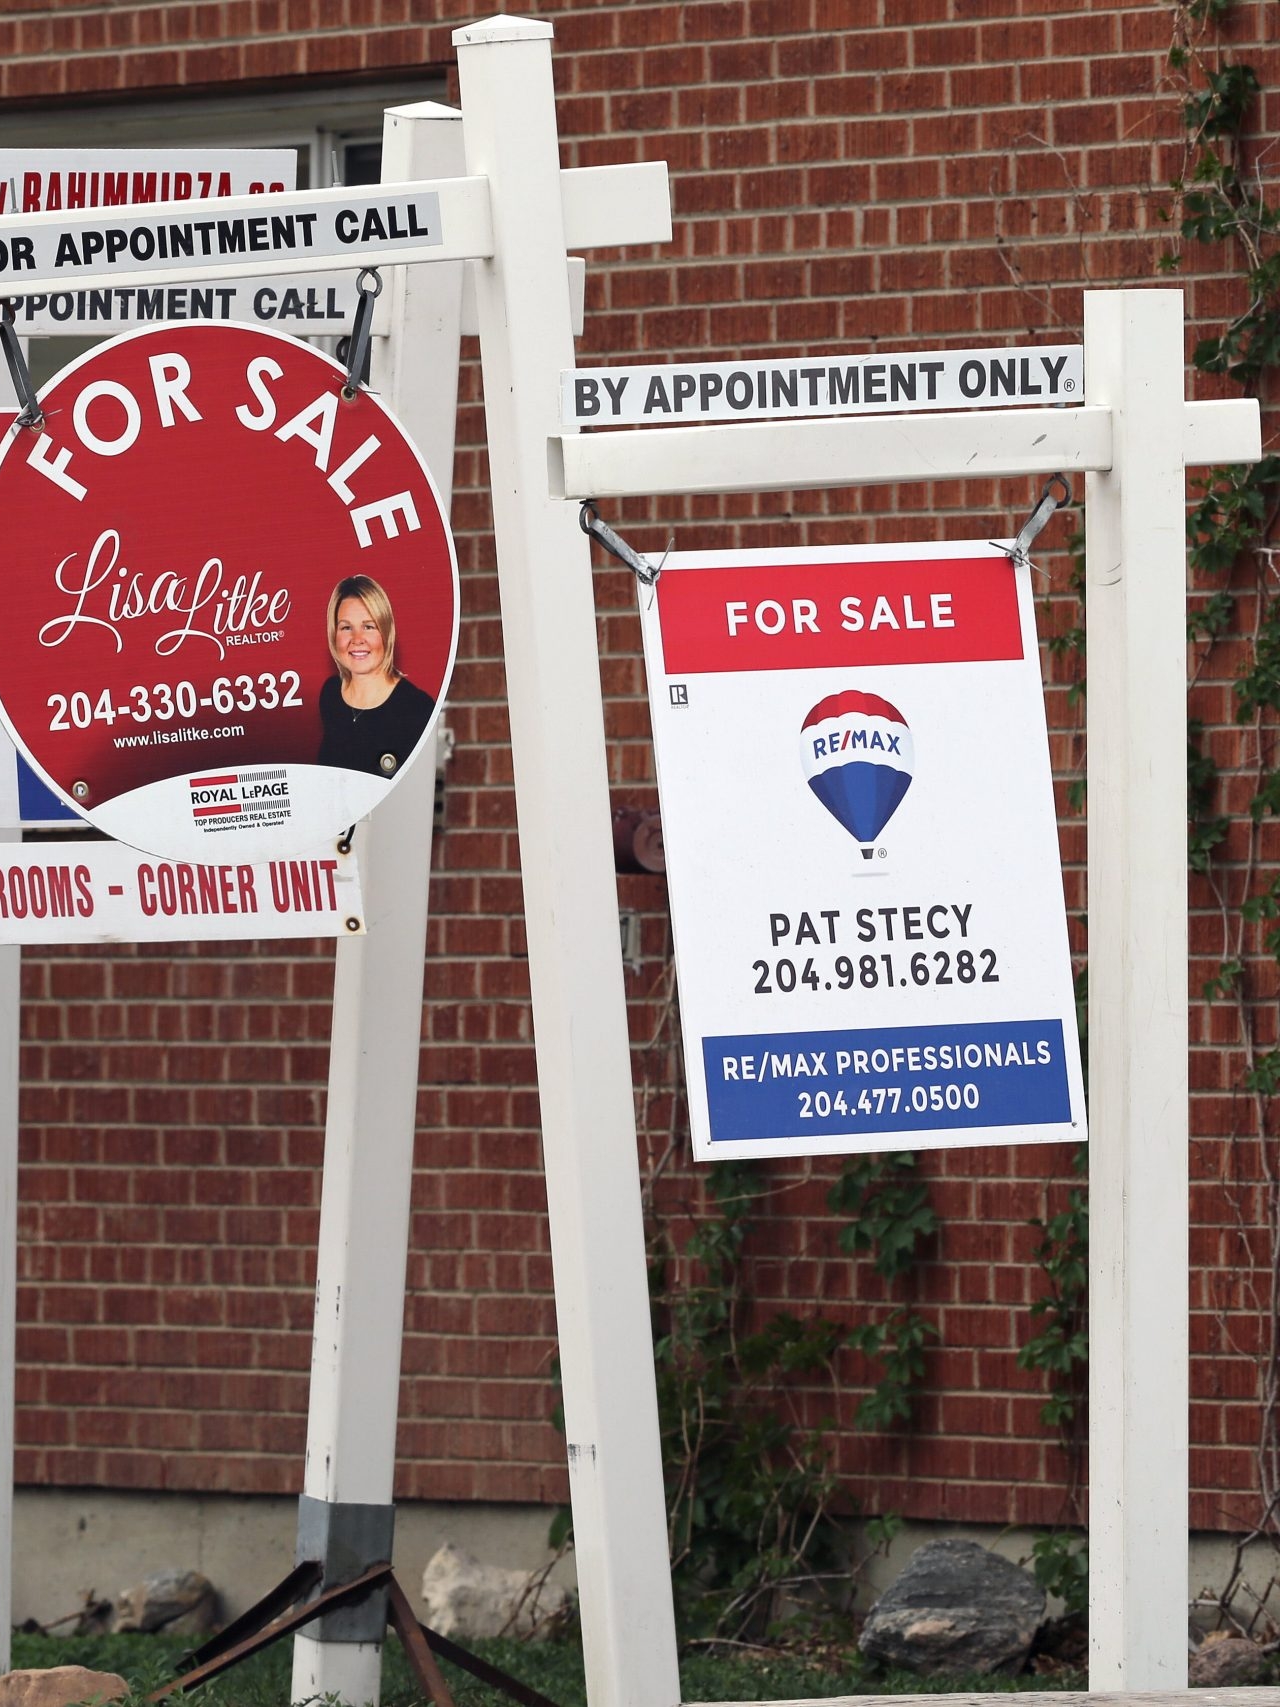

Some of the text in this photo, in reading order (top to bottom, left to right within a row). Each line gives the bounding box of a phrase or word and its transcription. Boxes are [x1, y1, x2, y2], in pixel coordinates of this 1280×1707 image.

[55, 213, 318, 268] APPOINTMENT
[334, 204, 428, 245] CALL
[253, 287, 345, 320] CALL
[575, 376, 630, 417] BY
[643, 361, 945, 414] APPOINTMENT
[26, 352, 421, 549] FOR SALE
[39, 529, 291, 661] Lisa Litke
[726, 592, 955, 637] FOR SALE
[47, 670, 303, 731] 204-330-6332
[113, 724, 245, 748] www.lisalitke.com
[813, 729, 901, 759] RE/MAX
[191, 788, 237, 804] ROYAL
[194, 809, 292, 827] TOP PRODUCERS REAL ESTATE
[204, 825, 237, 833] Independently
[262, 820, 284, 828] Operated
[137, 863, 258, 916] CORNER
[269, 860, 338, 913] UNIT
[769, 903, 973, 947] PAT STECY
[752, 948, 1000, 994] 204.981.6282
[722, 1040, 1052, 1083] RE/MAX PROFESSIONALS
[798, 1083, 980, 1118] 204.477.0500
